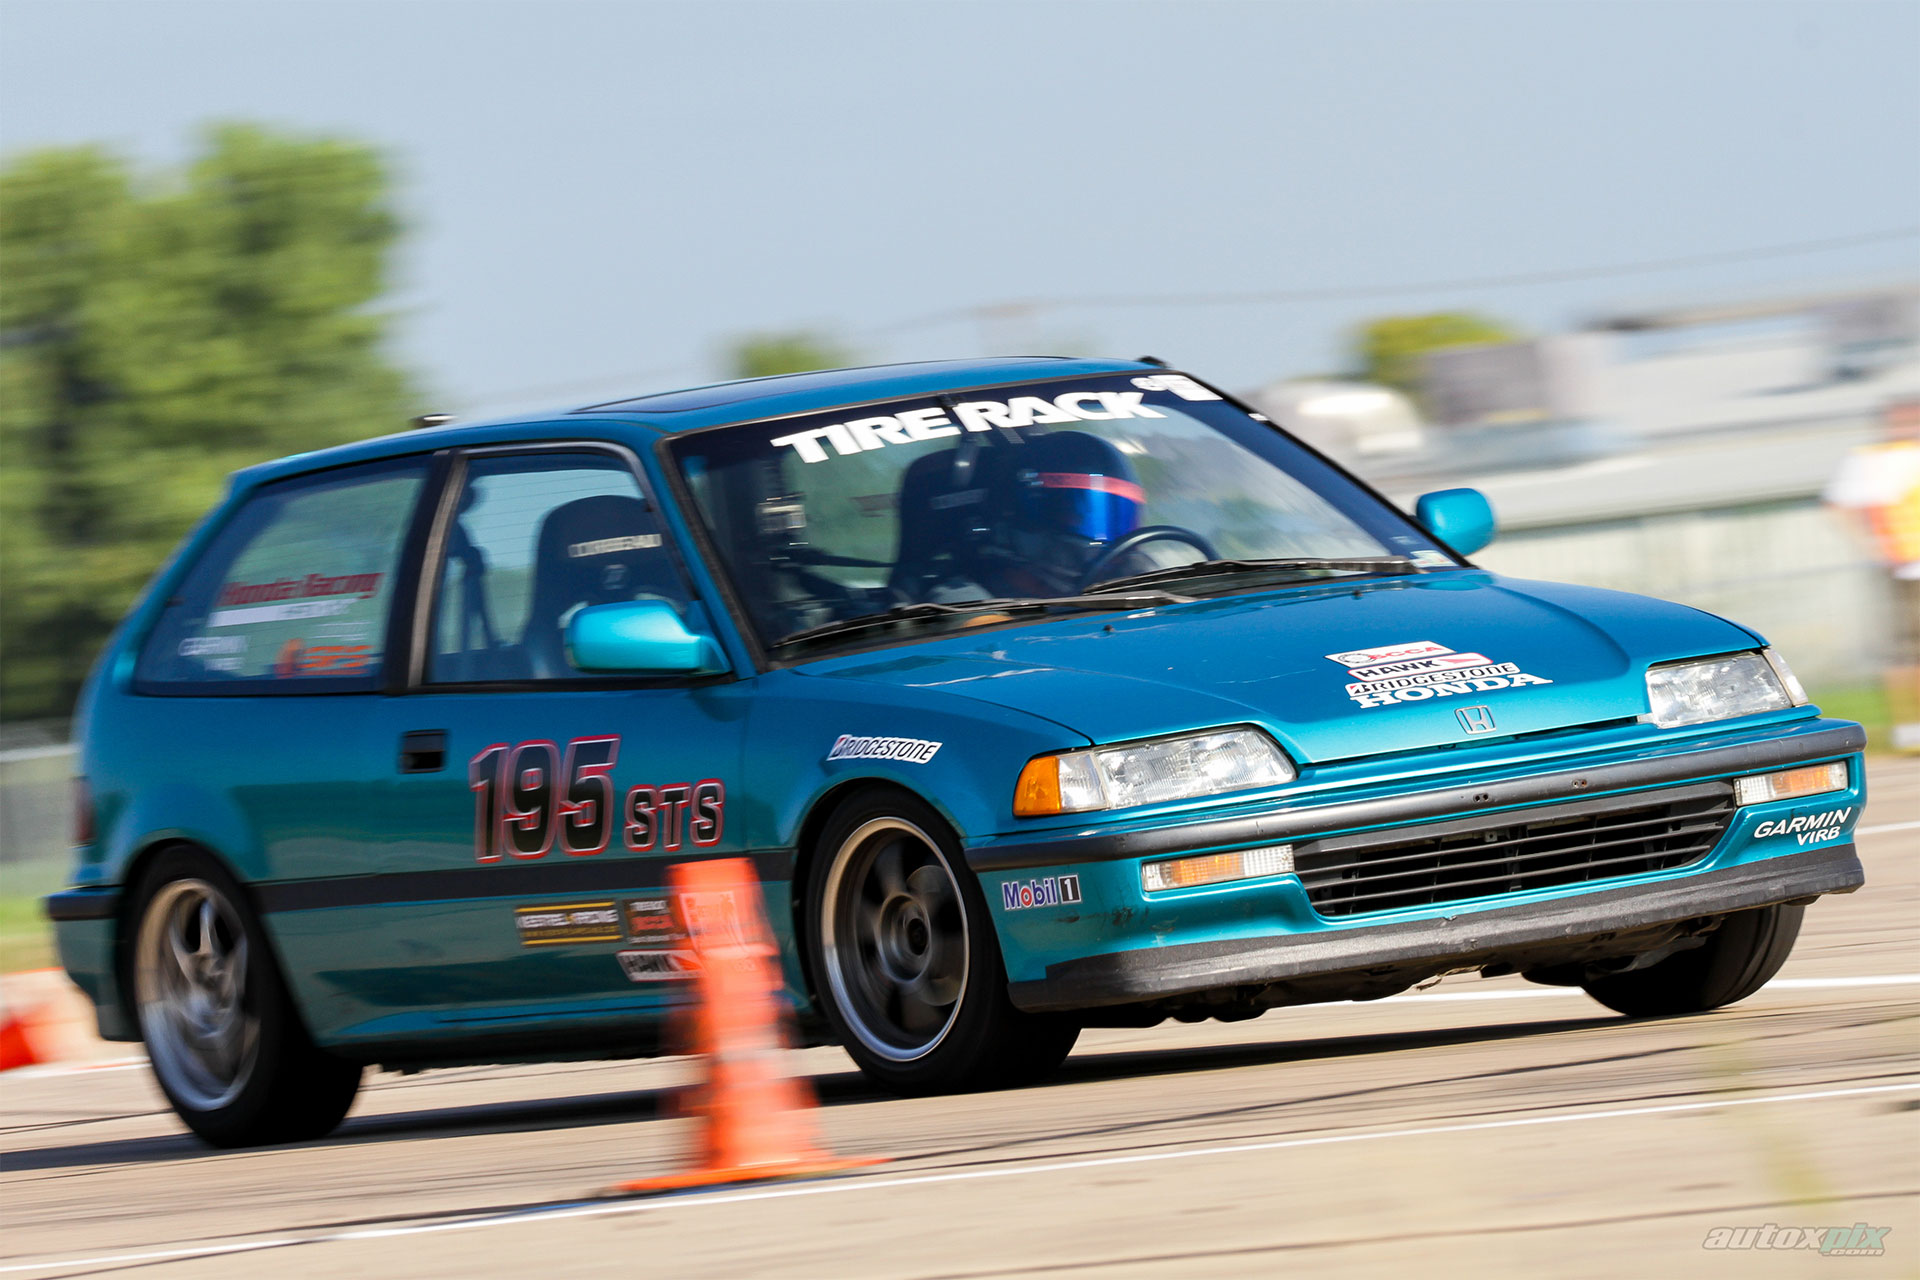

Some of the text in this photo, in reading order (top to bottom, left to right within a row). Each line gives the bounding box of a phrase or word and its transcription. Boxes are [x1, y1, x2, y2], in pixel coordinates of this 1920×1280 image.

[1350, 663, 1520, 694] BRIDGESTONE
[1356, 659, 1442, 678] HAWK
[1350, 673, 1554, 709] HONDA
[831, 736, 938, 762] BRIDGESTONE
[468, 733, 726, 864] 195 STS
[1753, 806, 1852, 838] GARMIN
[1797, 825, 1841, 846] VIRB
[1002, 878, 1057, 910] Mobil
